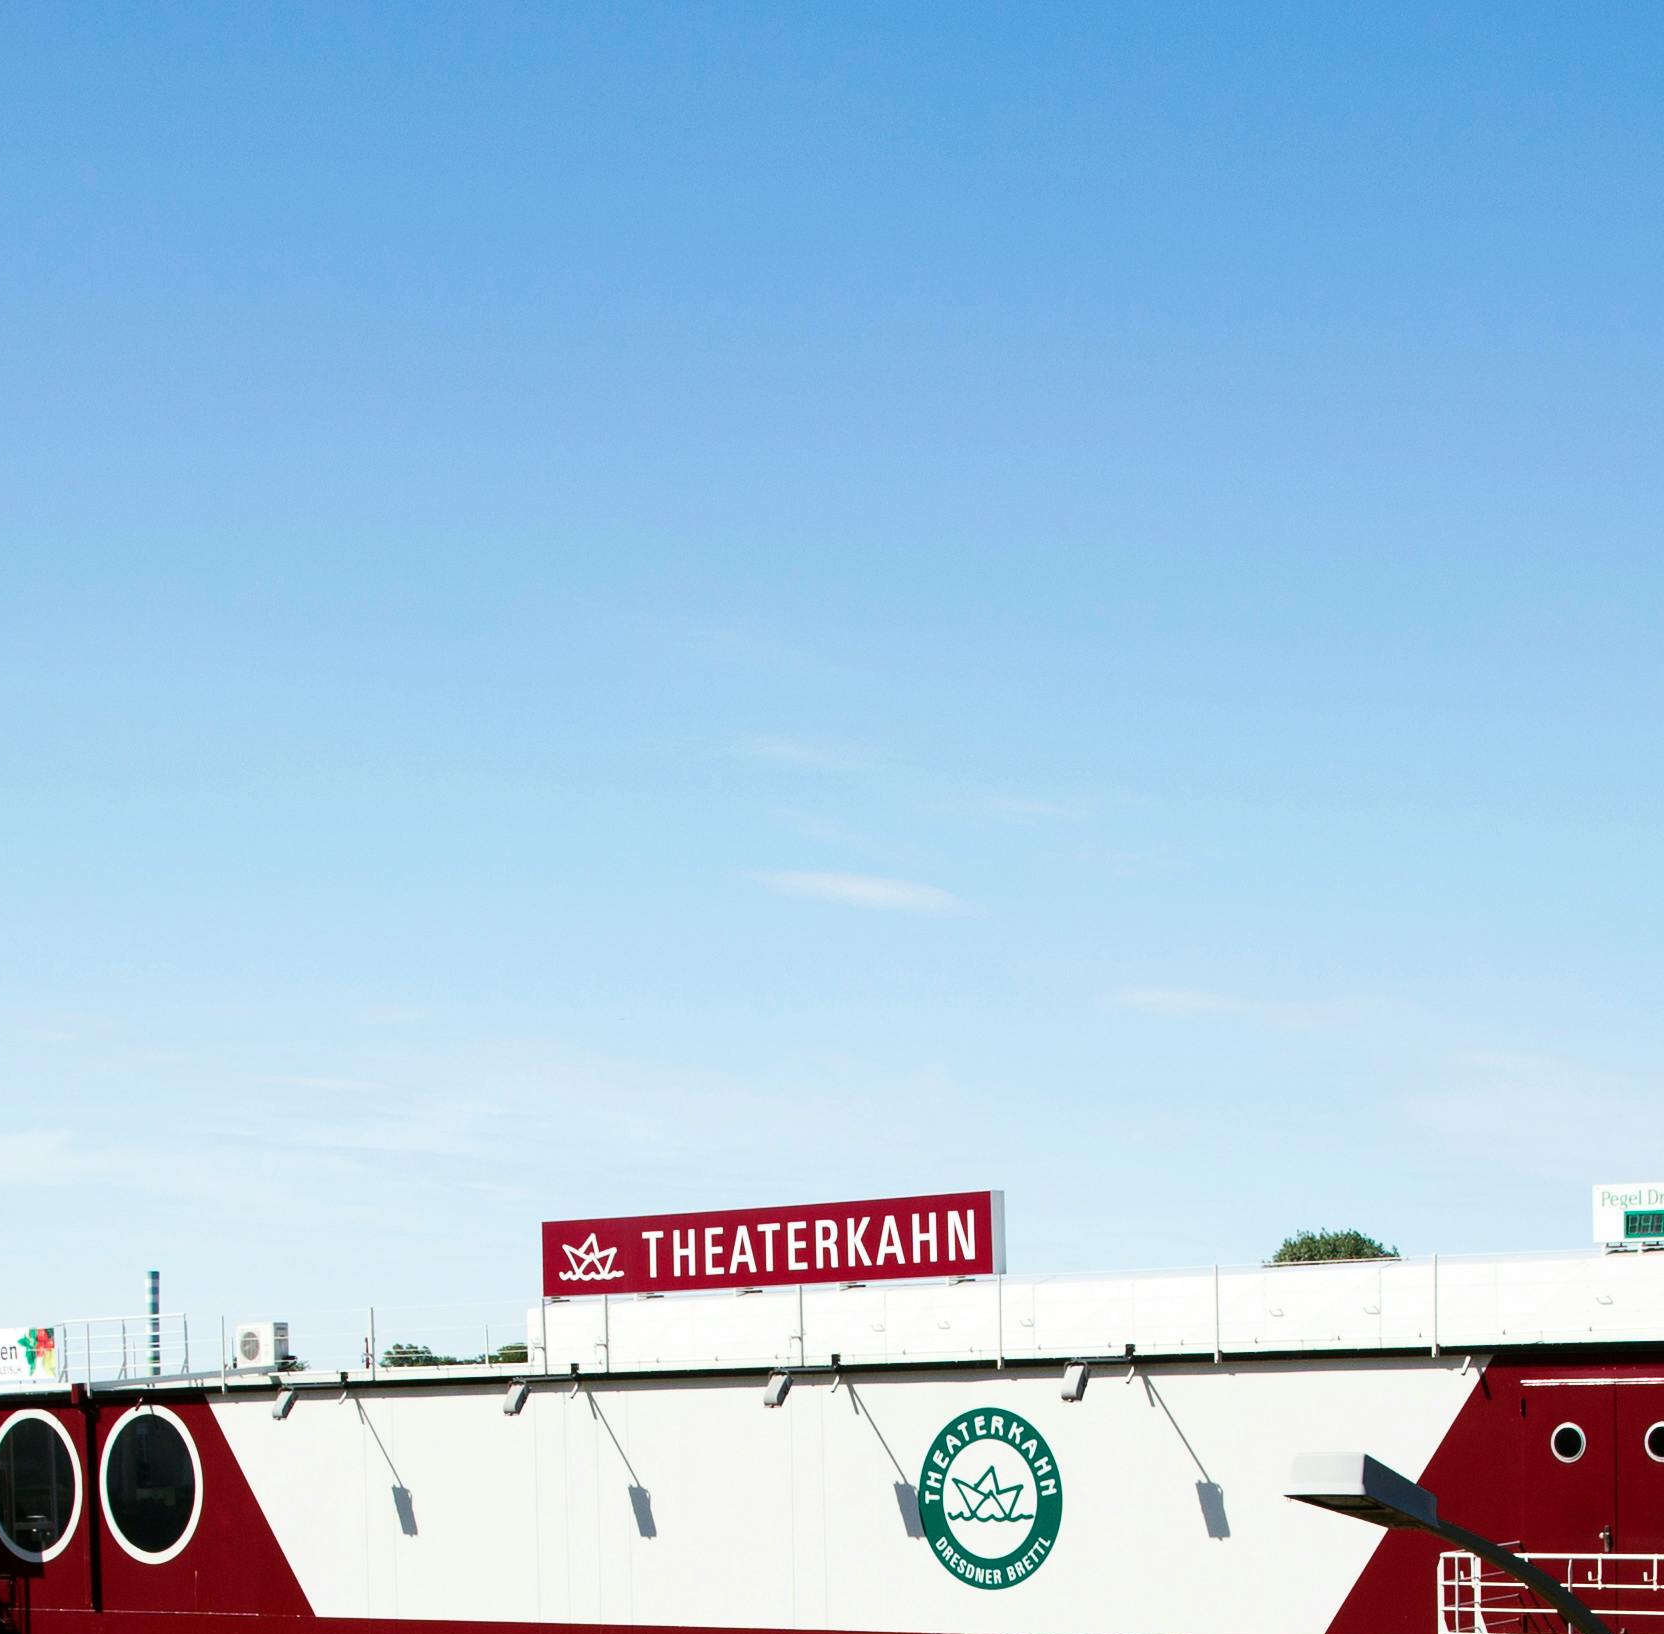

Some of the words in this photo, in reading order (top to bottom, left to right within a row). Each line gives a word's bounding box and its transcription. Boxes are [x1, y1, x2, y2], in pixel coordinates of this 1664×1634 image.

[1601, 1189, 1642, 1210] Pegel
[641, 1209, 977, 1278] THEATERKAHN
[925, 1415, 1057, 1504] THEATERKAHN
[935, 1536, 1002, 1585] DRESDNER
[1006, 1537, 1051, 1582] BRETTL
